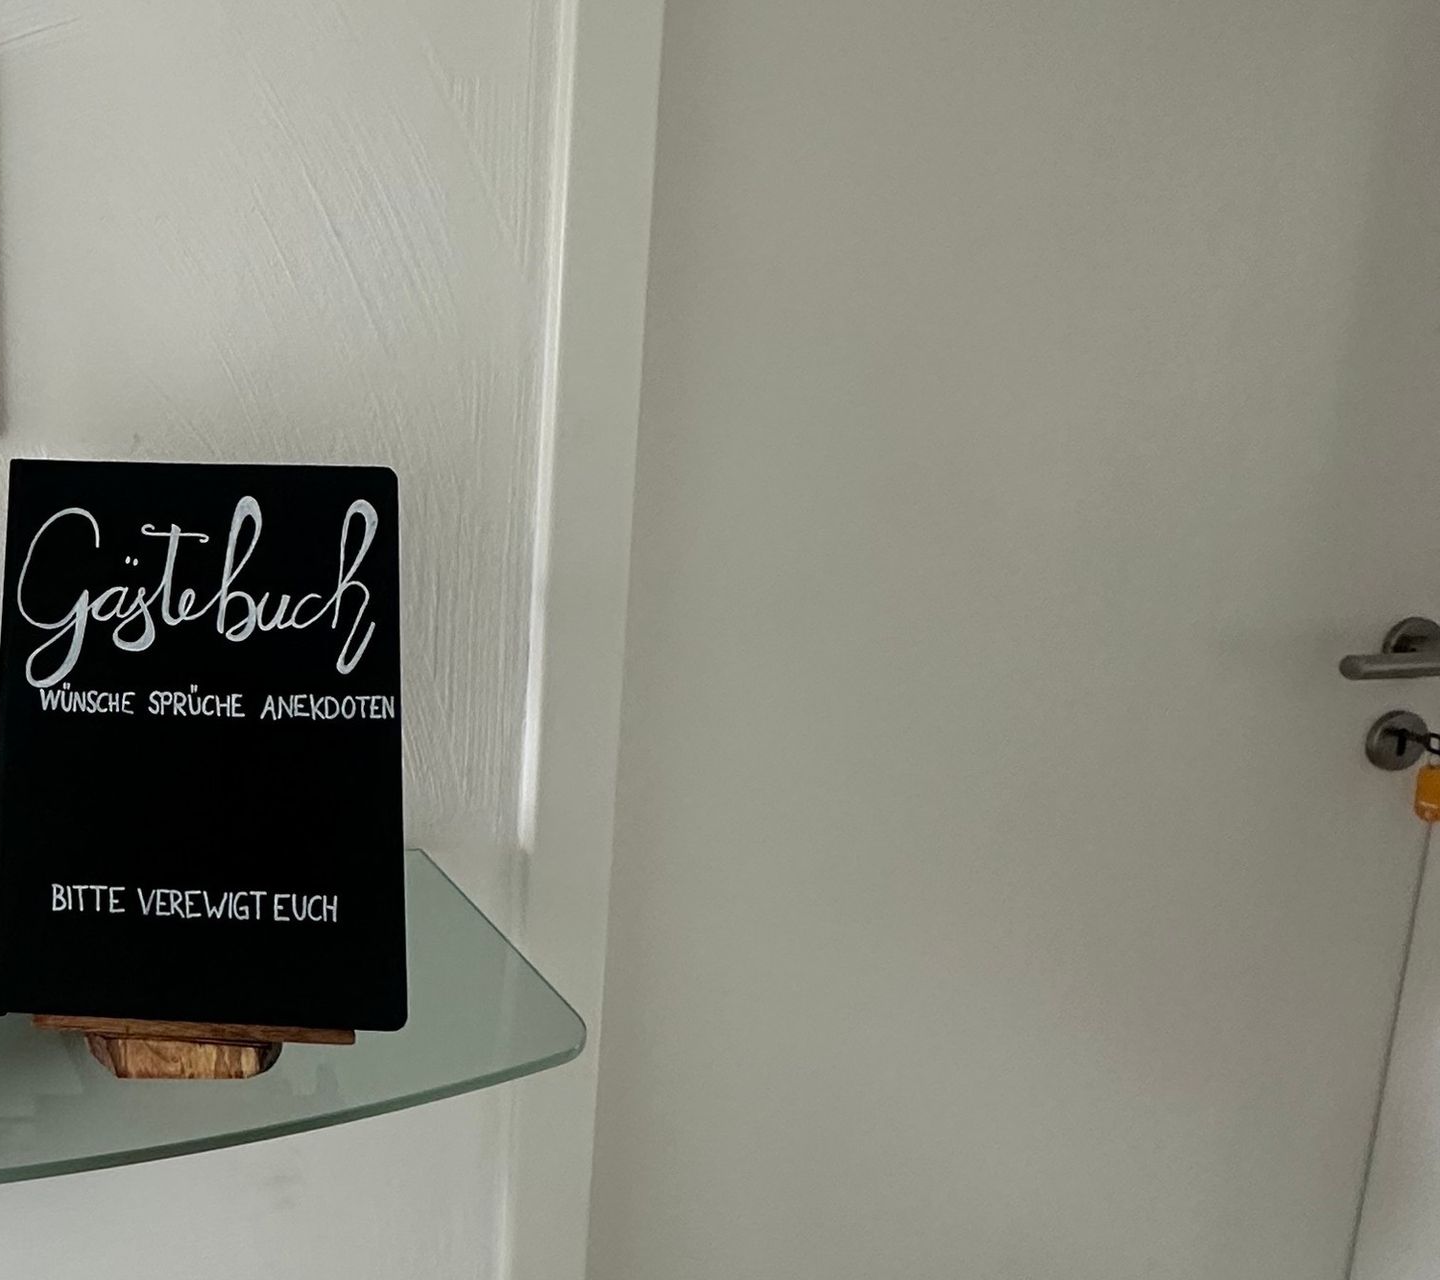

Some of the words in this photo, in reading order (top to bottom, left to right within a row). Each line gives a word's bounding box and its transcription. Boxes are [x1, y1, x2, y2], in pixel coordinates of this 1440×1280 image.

[17, 495, 379, 688] Gästebuch
[39, 682, 136, 716] WÜNSCHE
[147, 684, 246, 718] SPRÜCHE
[260, 694, 396, 721] ANEKDOTEN
[51, 883, 126, 914] BITTE
[137, 888, 267, 920] VEREWIGT
[273, 893, 338, 923] EUCH
